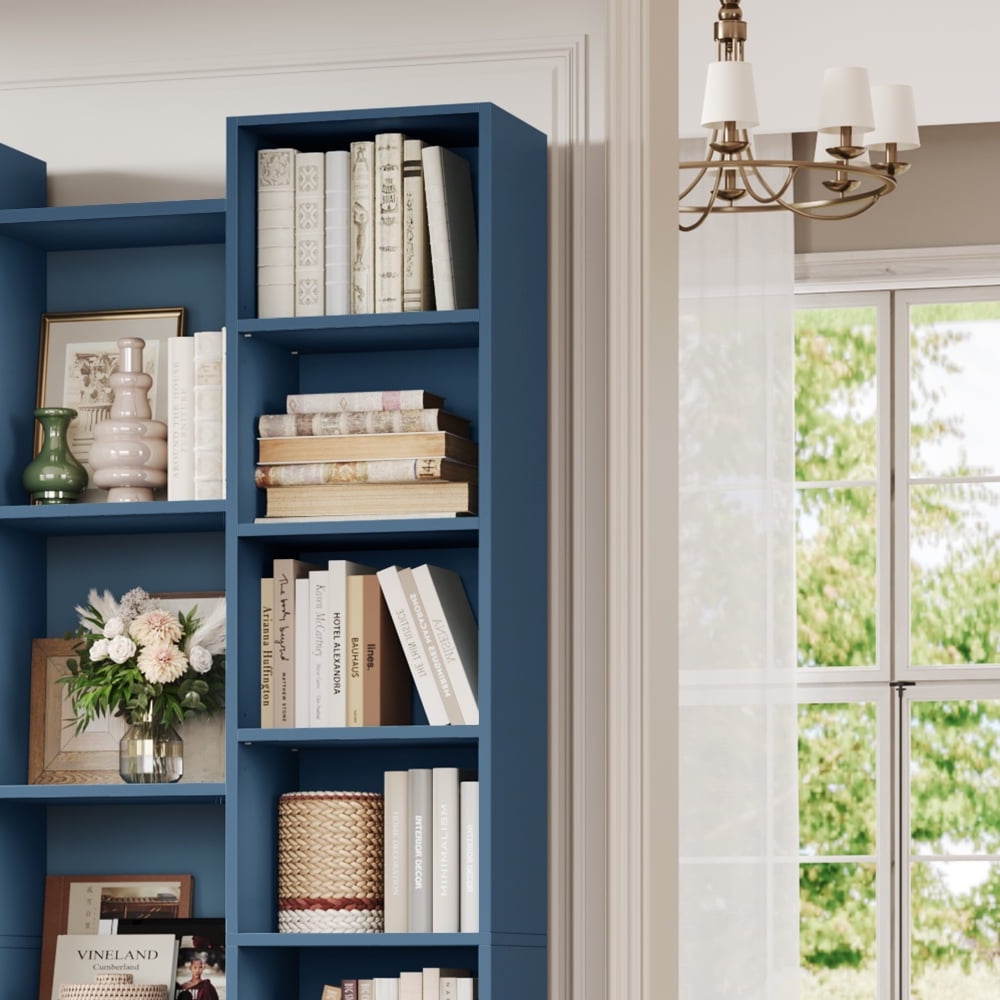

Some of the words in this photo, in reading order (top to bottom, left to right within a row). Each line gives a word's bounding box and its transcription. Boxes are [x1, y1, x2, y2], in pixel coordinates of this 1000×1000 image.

[279, 573, 289, 596] The
[315, 585, 326, 612] Karen
[262, 606, 272, 646] Arianna
[314, 613, 326, 657] McCartney
[333, 612, 341, 641] HOTEL
[333, 643, 341, 695] ALEXANDRA
[352, 637, 360, 678] BAUHAUS
[367, 643, 376, 671] lines.
[261, 650, 272, 706] Huffington
[77, 950, 159, 960] VINELAND
[92, 963, 140, 971] Cumberland
